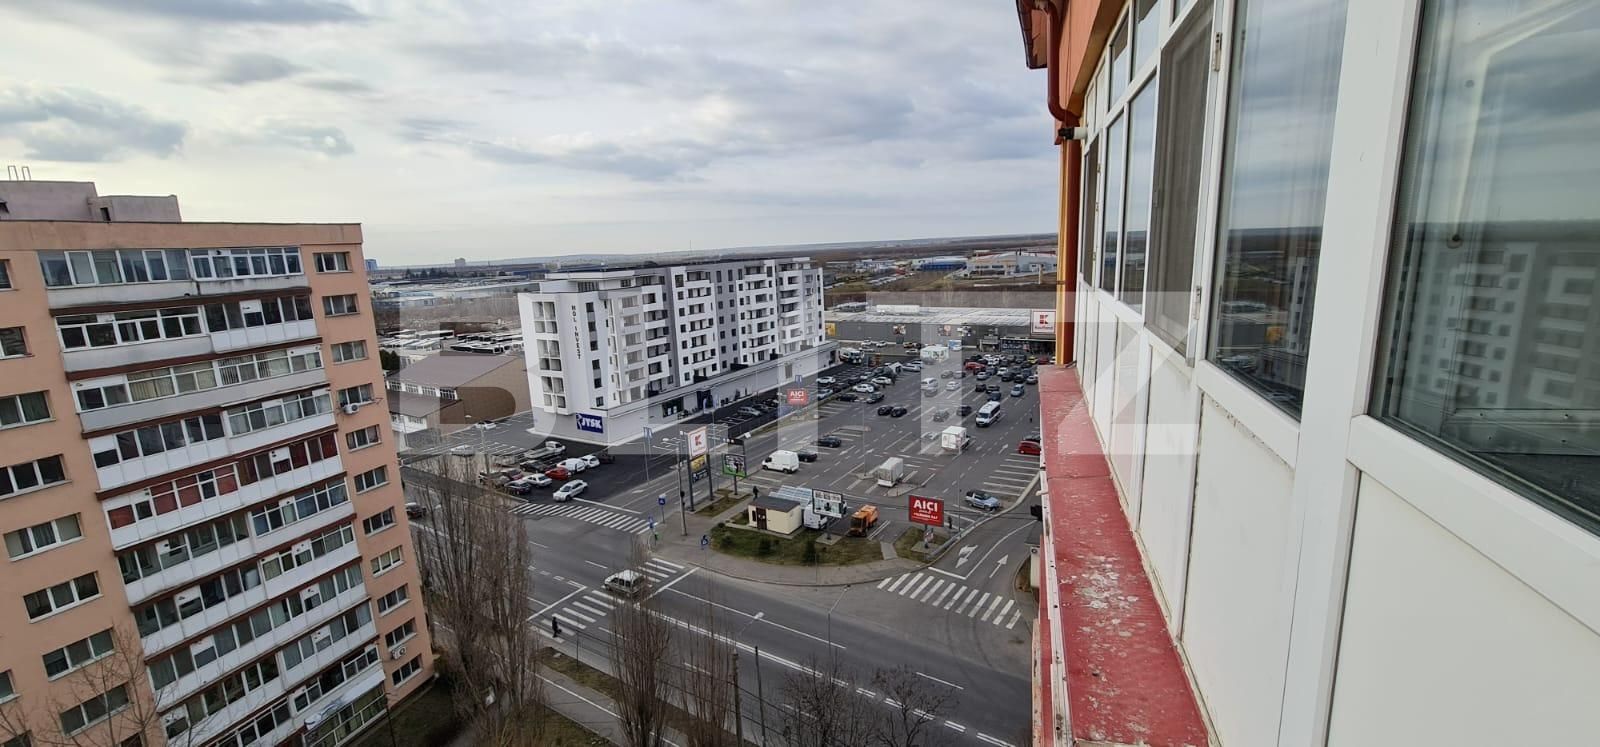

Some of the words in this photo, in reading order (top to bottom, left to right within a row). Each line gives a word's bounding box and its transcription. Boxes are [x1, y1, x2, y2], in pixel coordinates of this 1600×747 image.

[1039, 314, 1049, 324] K
[582, 417, 602, 429] JYSK
[694, 434, 702, 446] K
[913, 499, 938, 512] AICI
